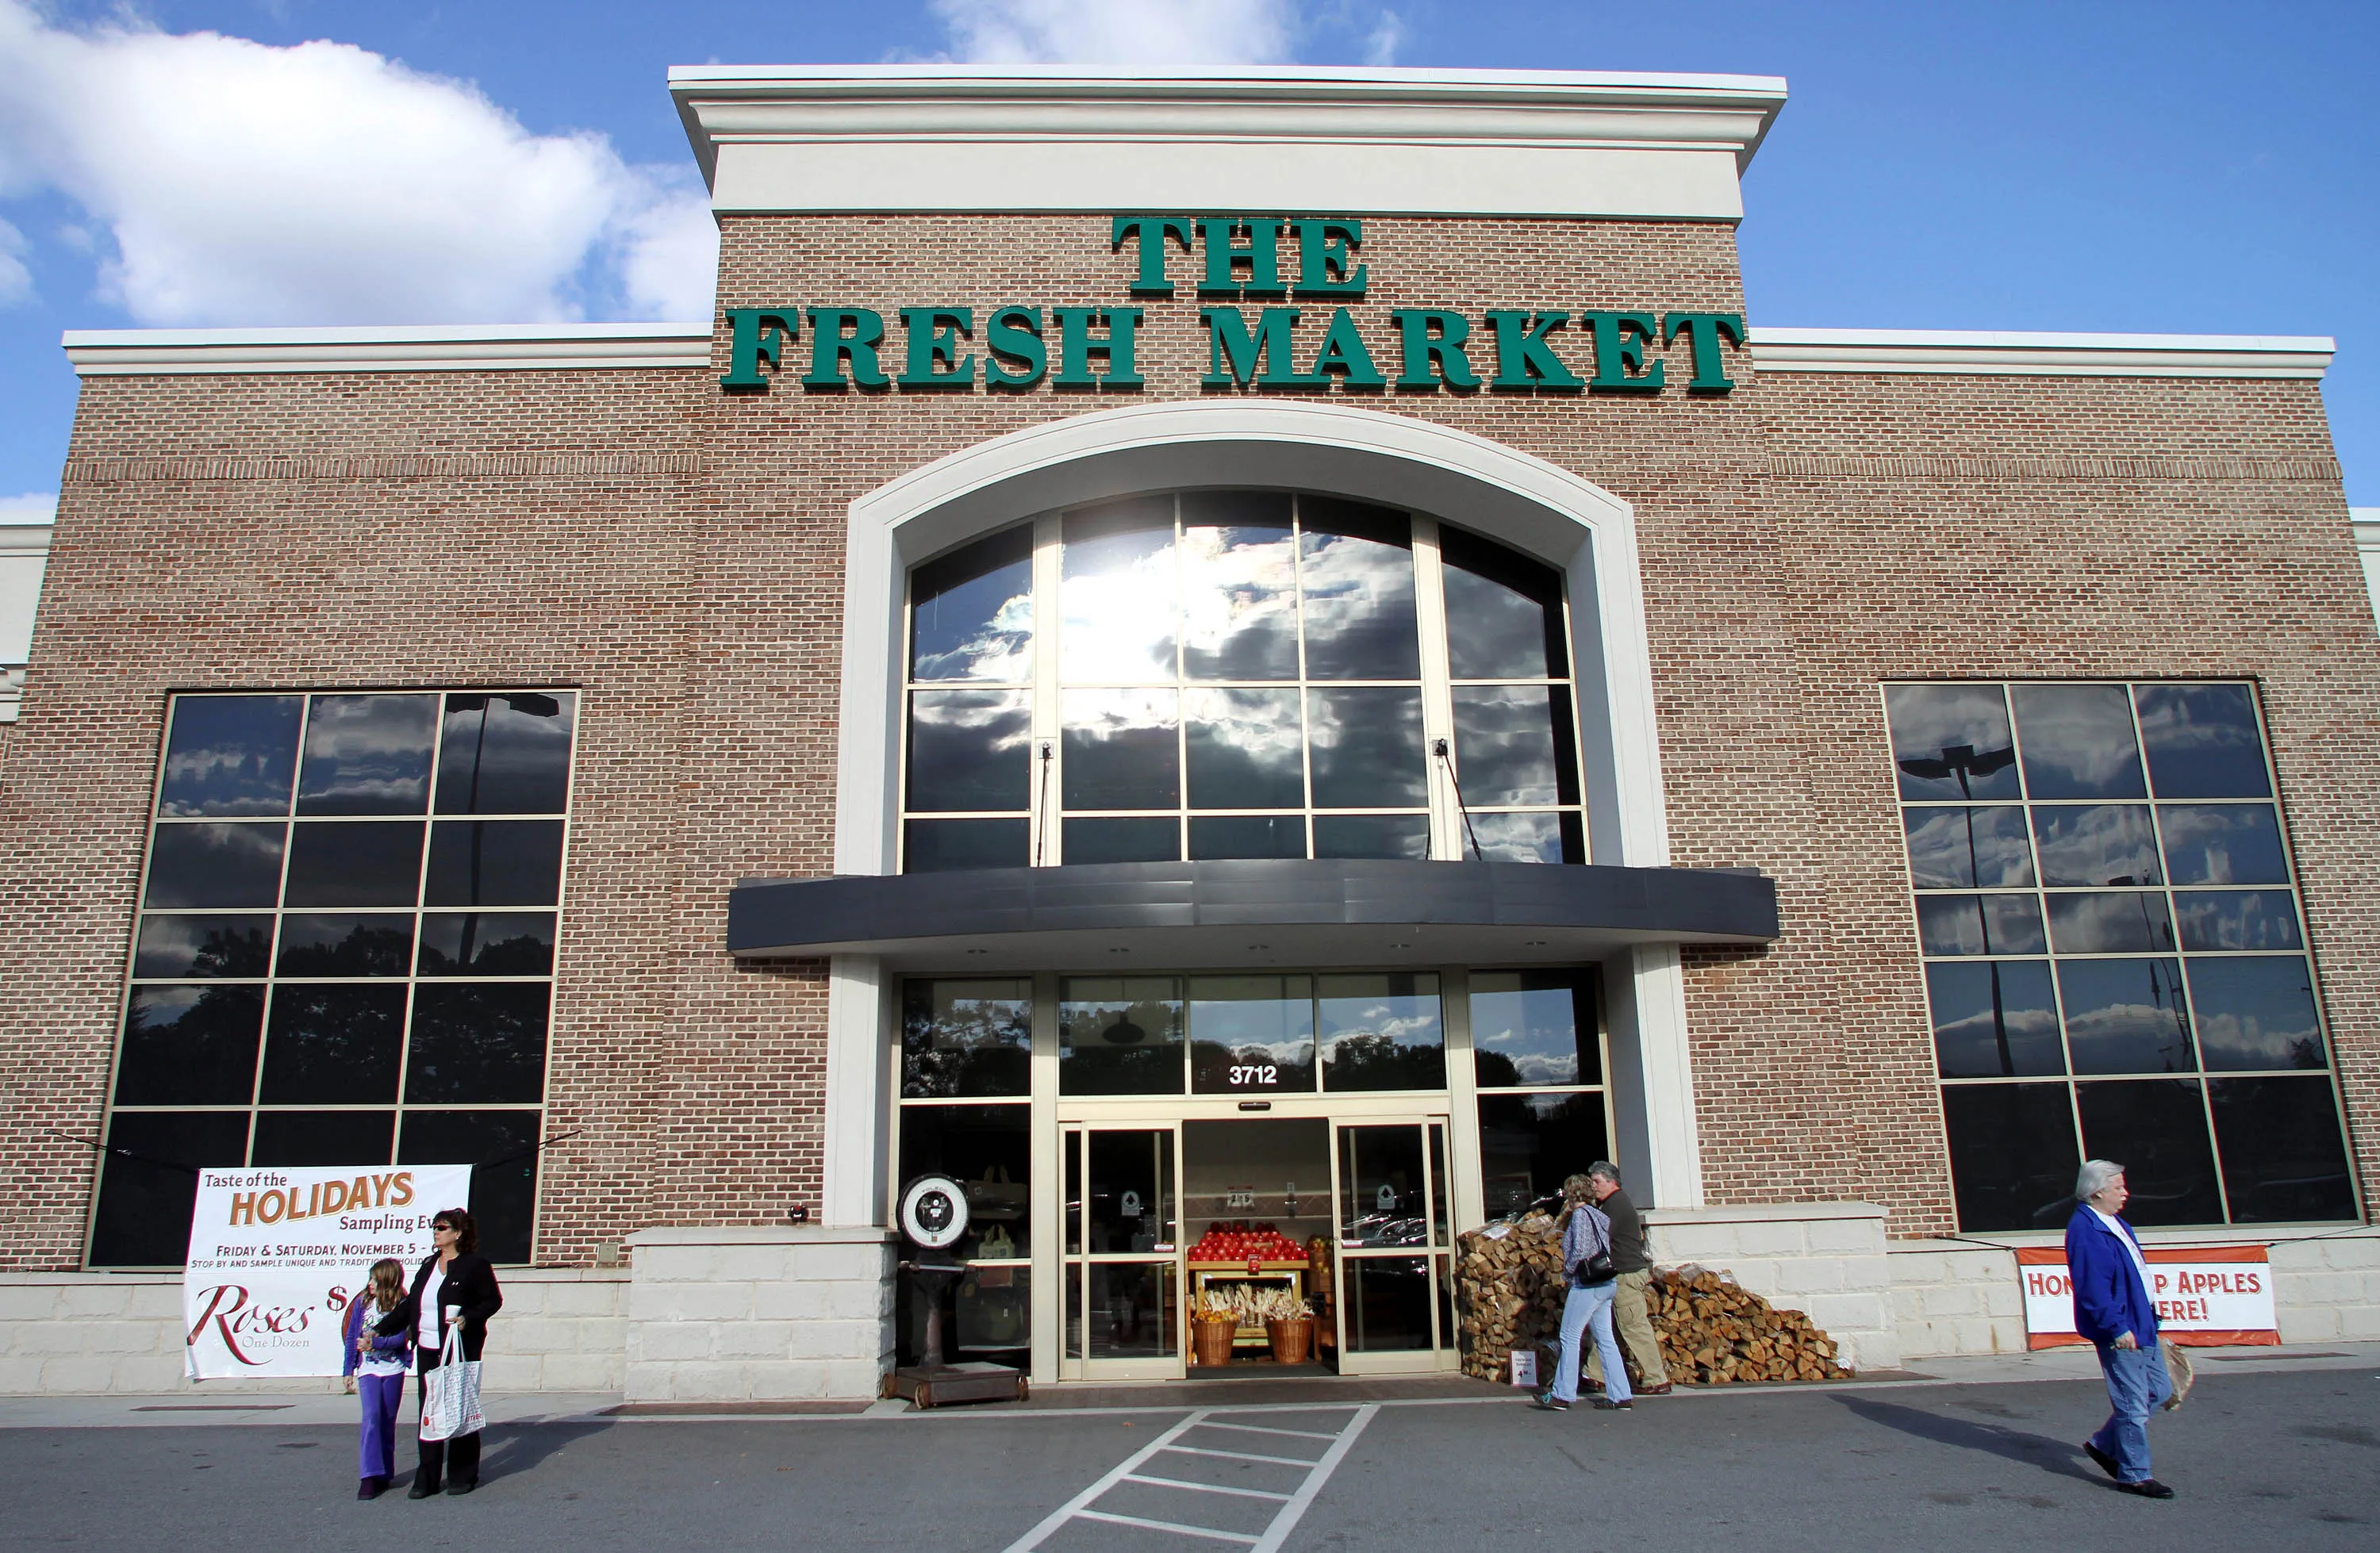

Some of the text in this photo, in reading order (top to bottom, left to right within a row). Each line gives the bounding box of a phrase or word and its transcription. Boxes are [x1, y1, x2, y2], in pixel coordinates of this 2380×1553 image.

[1111, 217, 1366, 297] THE
[720, 306, 1745, 394] FRESH MARKET
[1229, 1065, 1277, 1084] 3712
[205, 1172, 287, 1187] Taste of the
[228, 1171, 416, 1227] HOLIDAYS
[340, 1214, 435, 1233] Sampling Ev
[217, 1245, 257, 1256] FRIDAY
[261, 1244, 271, 1256] &
[341, 1244, 404, 1255] NOVEMBER
[408, 1243, 416, 1254] 5
[192, 1260, 214, 1268] STOP
[217, 1260, 227, 1268] BY
[230, 1260, 248, 1268] AND
[286, 1259, 317, 1267] UNIQUE
[340, 1258, 381, 1267] TRADITIO
[400, 1257, 423, 1266] HOLID
[2178, 1271, 2261, 1294] APPLES
[2156, 1298, 2209, 1321] ERE!
[187, 1284, 315, 1365] Roses
[242, 1335, 310, 1348] One Dozen
